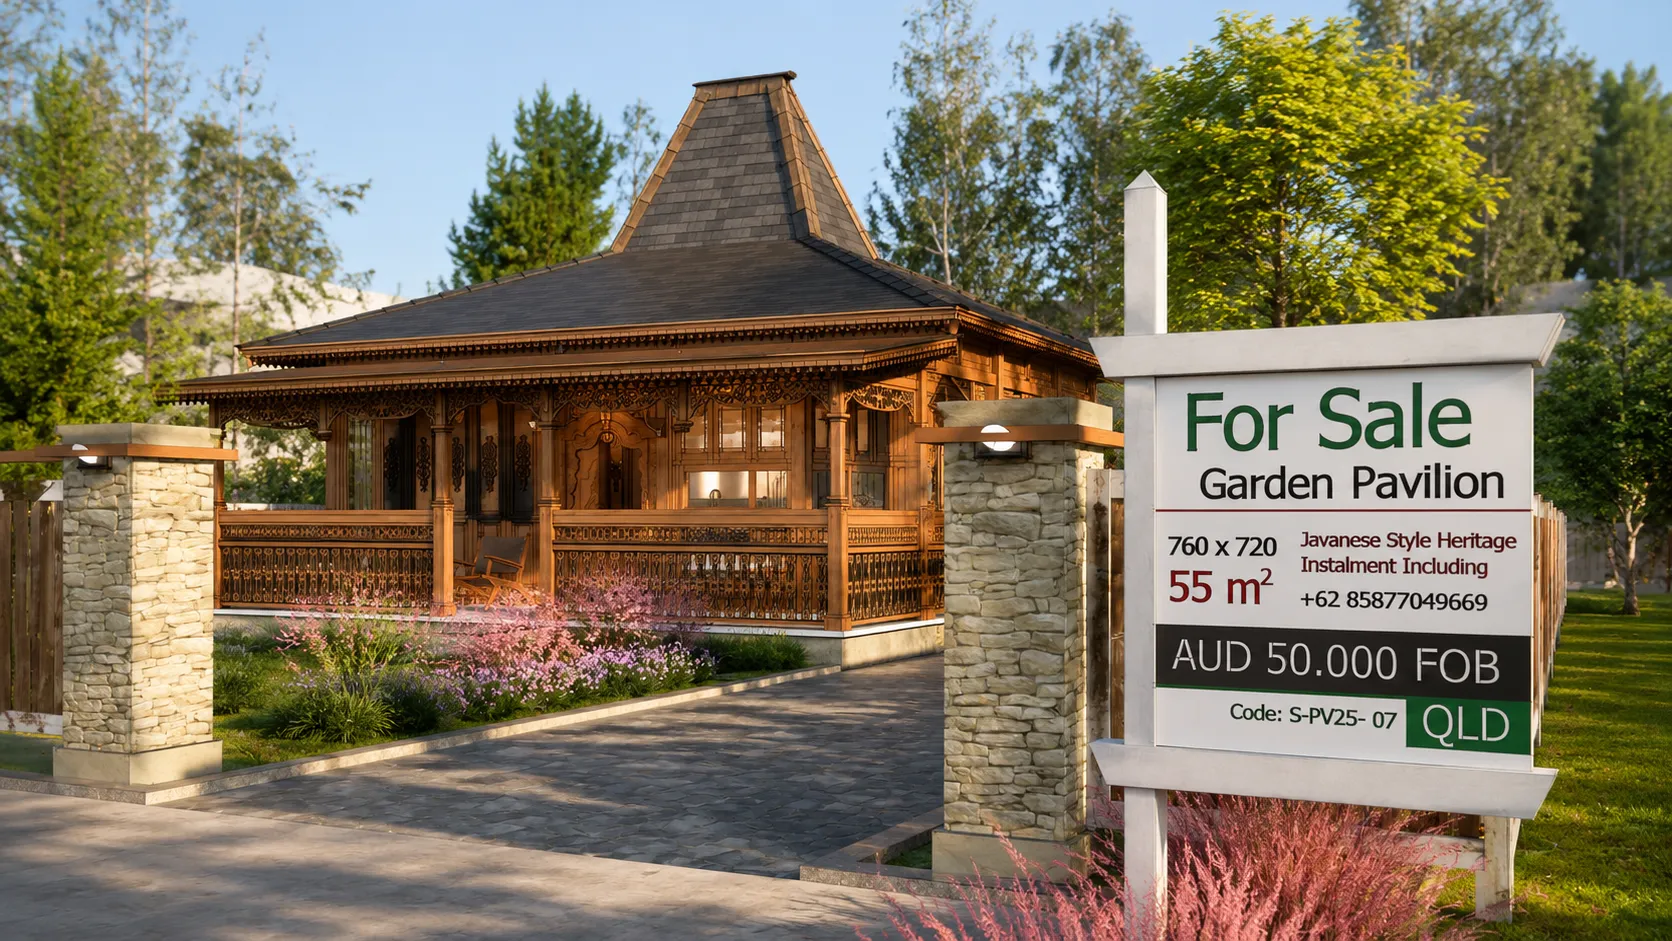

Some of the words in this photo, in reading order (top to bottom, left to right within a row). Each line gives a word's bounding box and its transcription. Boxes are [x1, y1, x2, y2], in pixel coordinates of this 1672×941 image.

[1186, 391, 1294, 452] For
[1318, 381, 1472, 451] Sale
[1199, 465, 1333, 500] Garden
[1353, 462, 1505, 500] Pavilion
[1167, 535, 1209, 556] 760
[1214, 540, 1230, 557] x
[1235, 536, 1278, 557] 720
[1300, 531, 1382, 549] Javanese
[1386, 530, 1432, 553] Style
[1437, 531, 1518, 554] Heritage
[1300, 555, 1398, 574] Instalment
[1402, 557, 1489, 580] Including
[1169, 569, 1213, 604] 55
[1300, 590, 1341, 608] +62
[1346, 590, 1488, 612] 85877049669
[1172, 638, 1252, 672] AUD
[1267, 642, 1397, 680] 50.000
[1416, 647, 1500, 684] FOB
[1230, 703, 1282, 722] Code:
[1289, 706, 1366, 727] S-PV25-
[1372, 711, 1398, 730] 07
[1422, 704, 1510, 748] QLD
